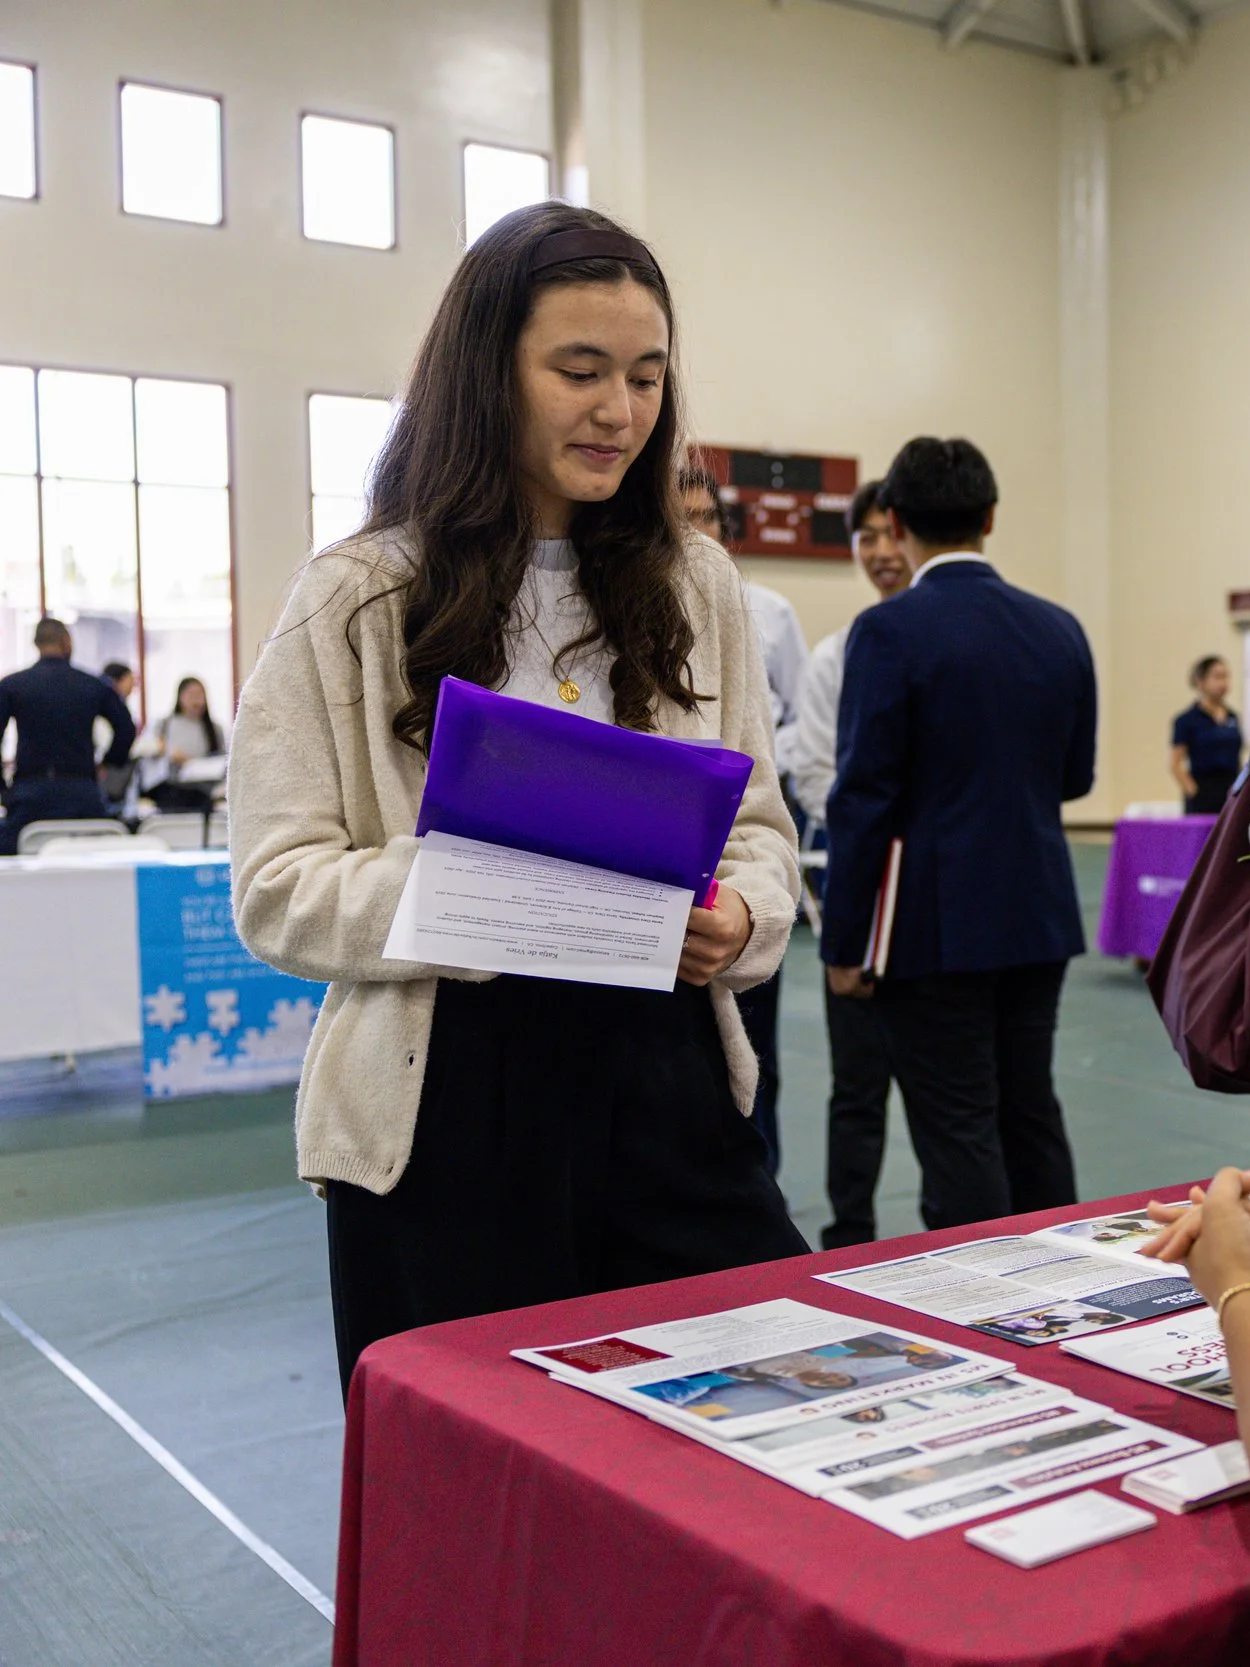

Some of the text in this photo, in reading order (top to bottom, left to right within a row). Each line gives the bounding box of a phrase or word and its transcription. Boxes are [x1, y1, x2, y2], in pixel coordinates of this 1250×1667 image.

[505, 946, 525, 954] Vries
[1149, 1351, 1228, 1374] HOOL
[821, 1364, 990, 1408] MS IN MARKETING
